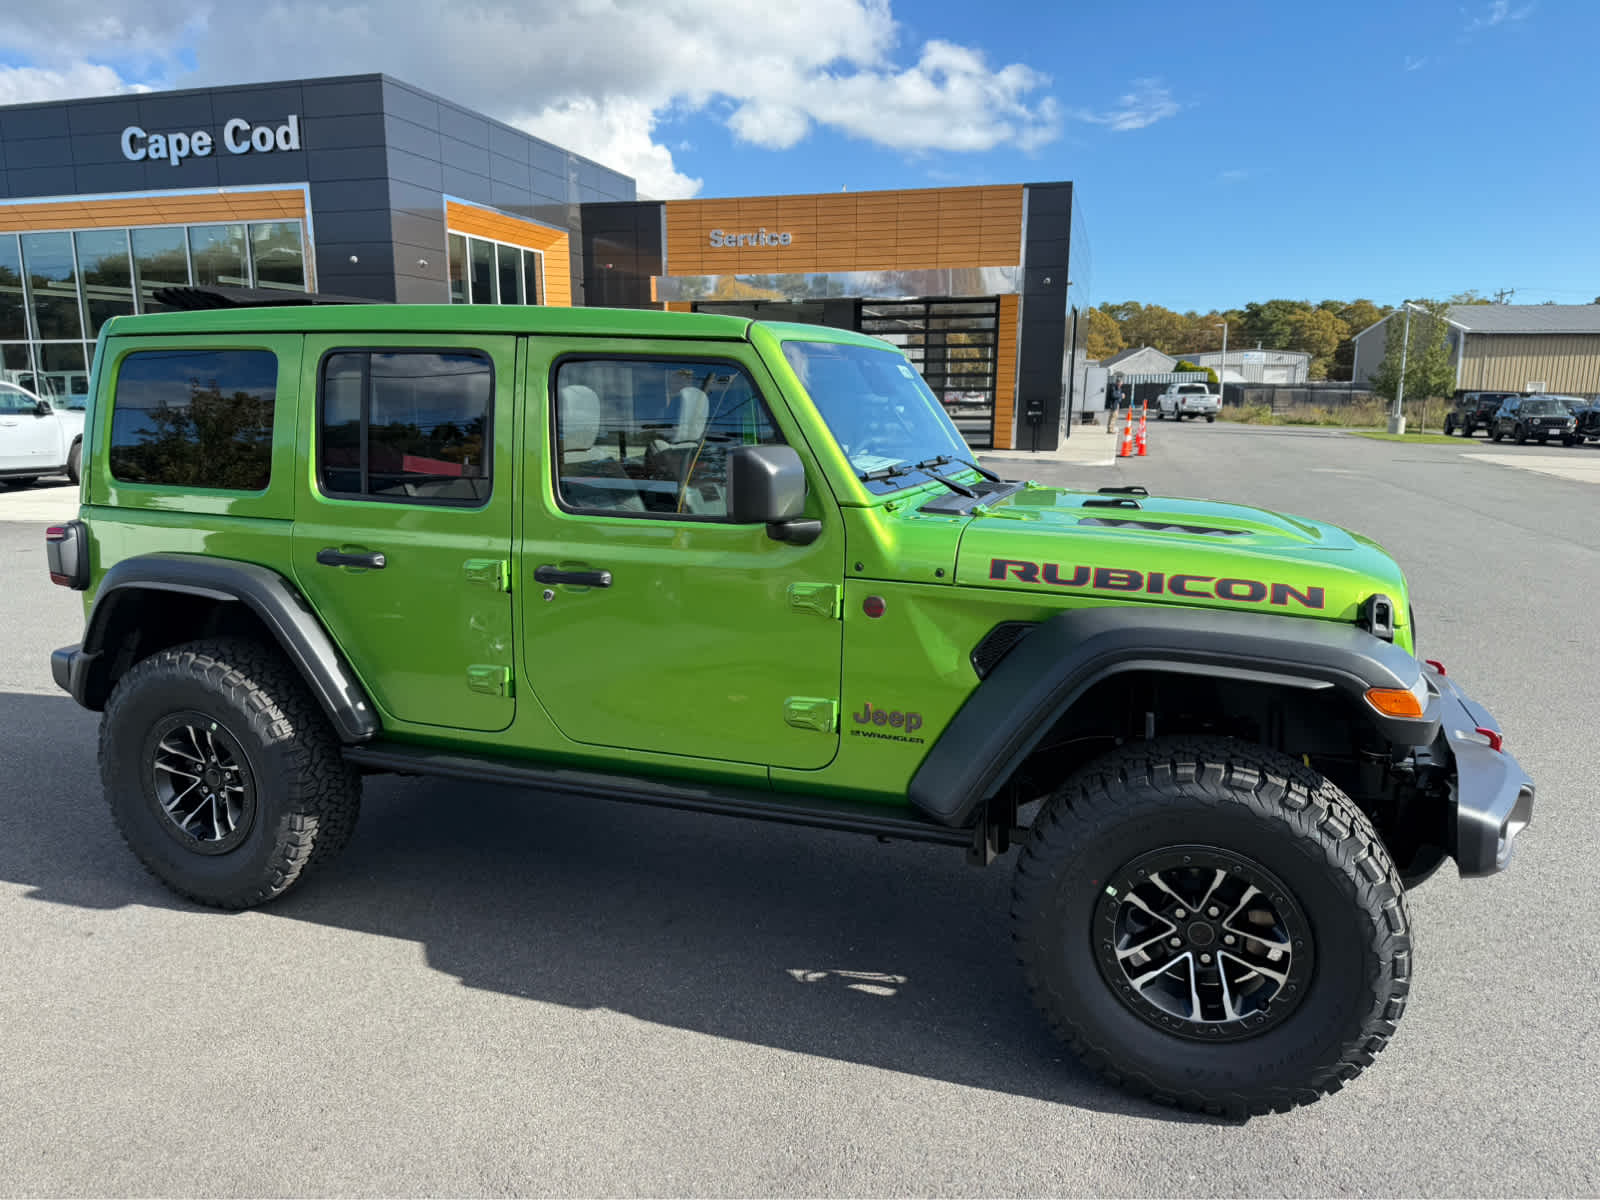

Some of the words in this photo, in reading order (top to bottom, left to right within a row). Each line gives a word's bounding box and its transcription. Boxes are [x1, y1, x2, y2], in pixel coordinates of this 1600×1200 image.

[121, 126, 213, 166] Cape
[223, 114, 301, 154] Cod
[709, 227, 793, 248] Service
[989, 558, 1325, 609] RUBICON
[853, 702, 923, 734] Jeep
[861, 730, 925, 744] WRANGLER
